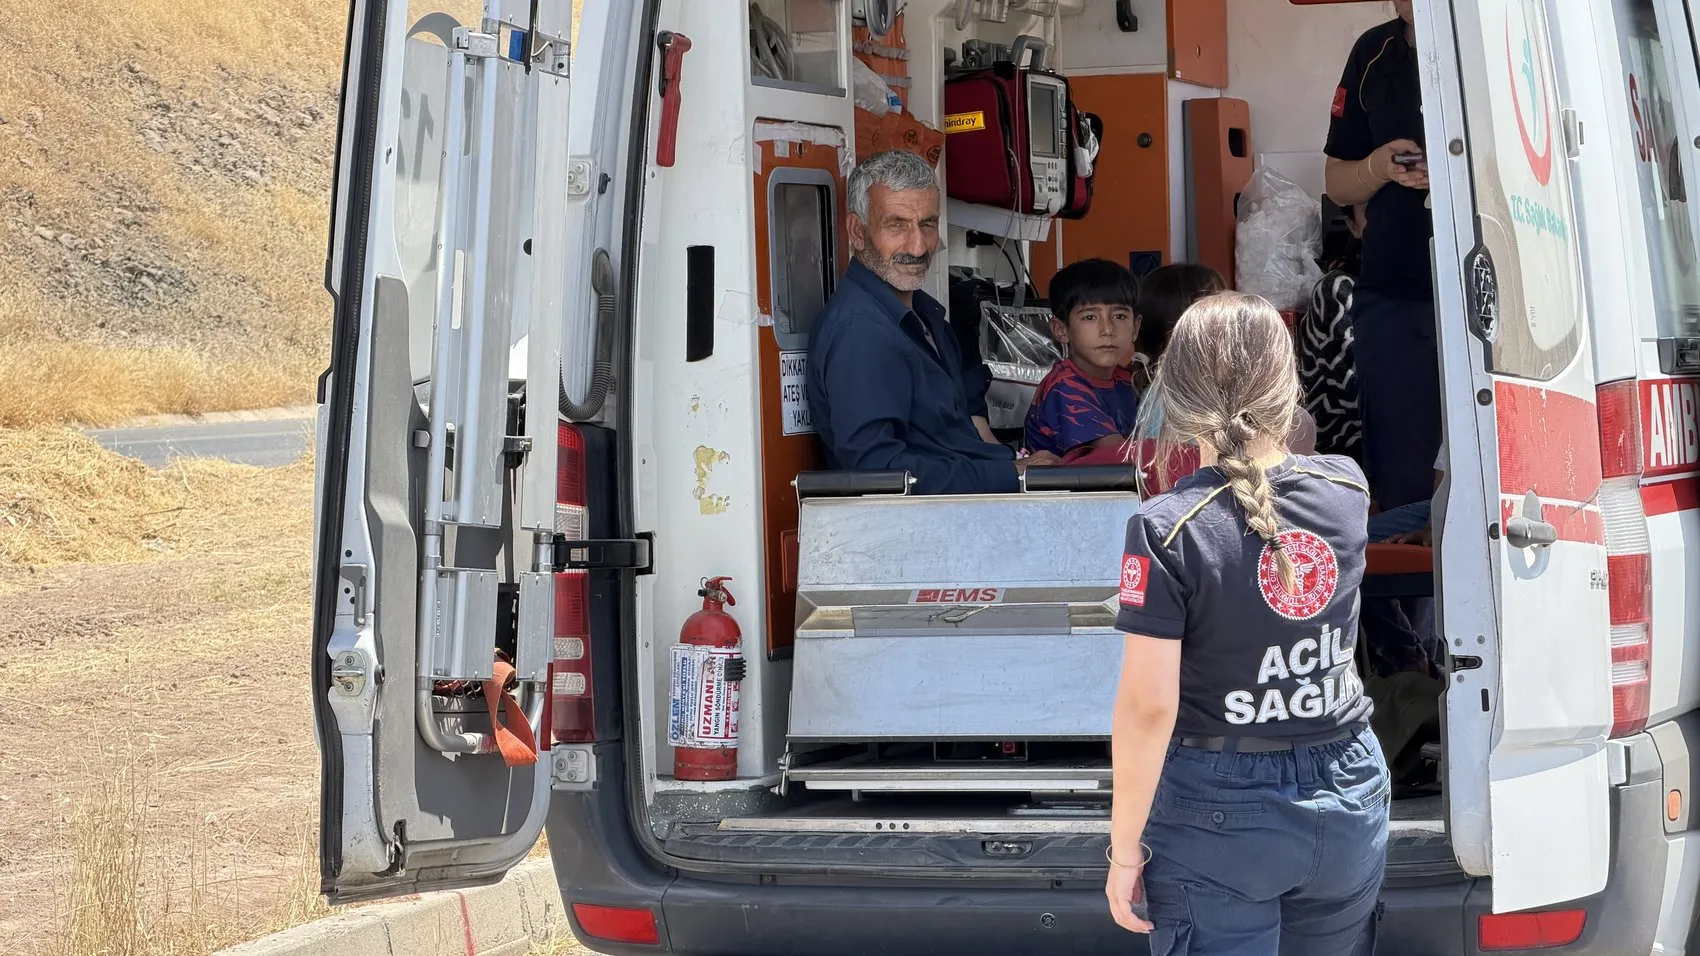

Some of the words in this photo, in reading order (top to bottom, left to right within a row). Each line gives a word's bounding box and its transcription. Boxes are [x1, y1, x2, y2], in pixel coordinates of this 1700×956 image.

[781, 358, 806, 377] DİKKAT
[783, 384, 800, 406] ATEŞ
[1650, 383, 1700, 468] AMB
[939, 588, 998, 603] EMS
[1257, 624, 1353, 684] ACİL
[671, 698, 680, 740] ÖZLEM
[713, 712, 721, 736] YANGIN
